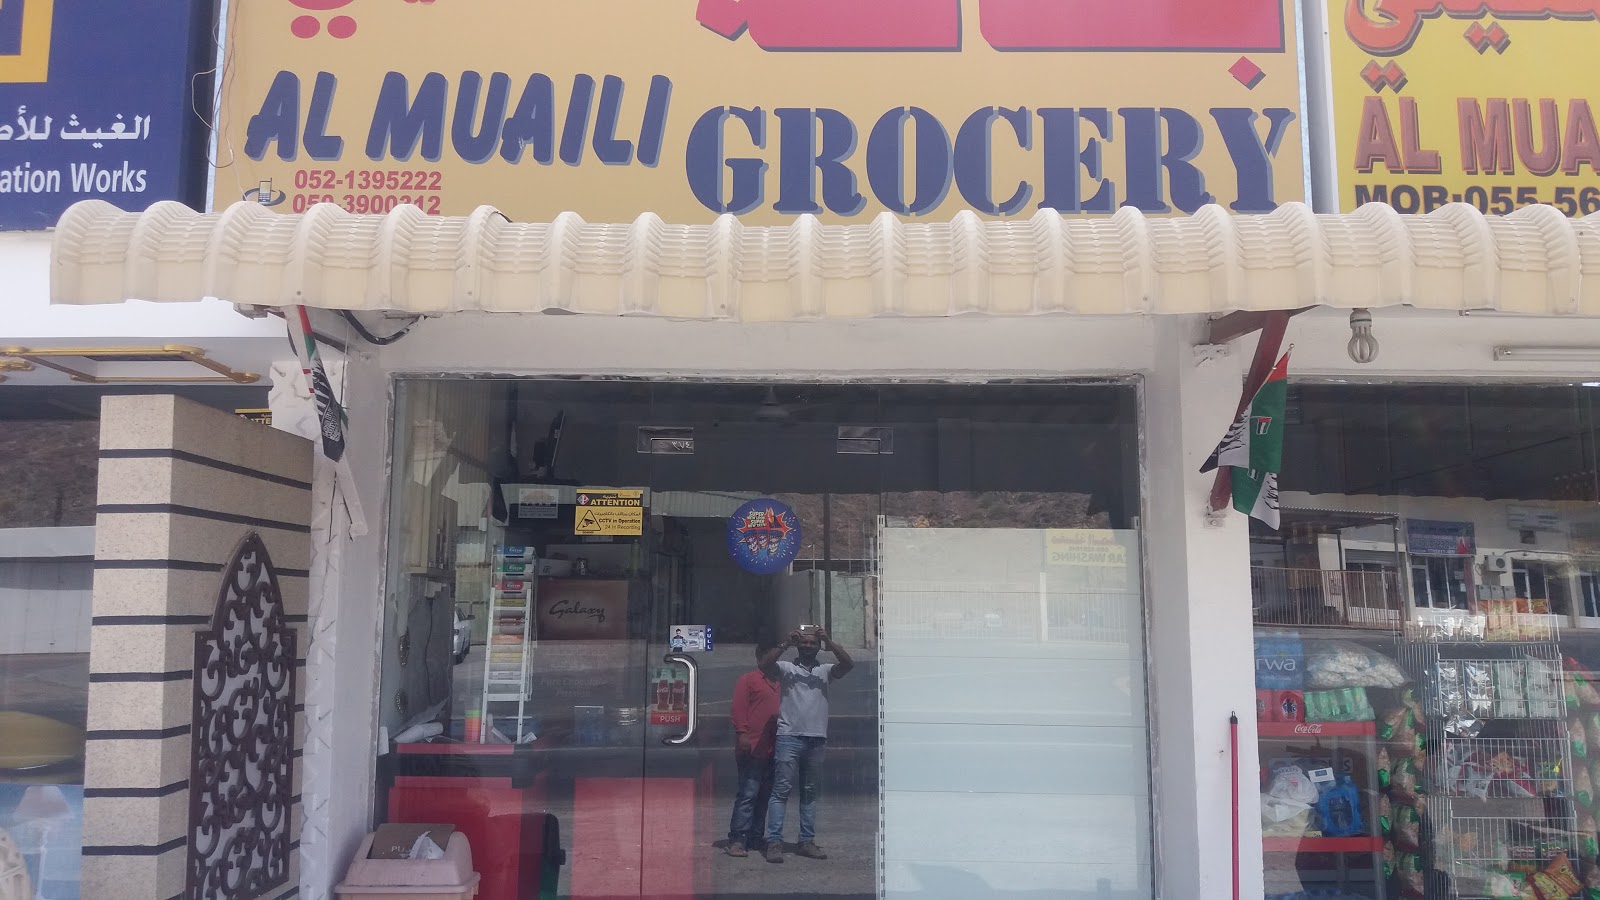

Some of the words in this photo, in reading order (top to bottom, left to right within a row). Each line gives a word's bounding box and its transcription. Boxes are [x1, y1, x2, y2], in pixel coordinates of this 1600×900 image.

[60, 113, 151, 149] الغيث
[244, 70, 344, 162] AL
[365, 70, 673, 168] MUAILI
[1354, 96, 1442, 175] AL
[1457, 97, 1600, 177] MUA
[70, 160, 147, 193] Works
[685, 105, 1297, 216] GROCERY
[294, 169, 442, 191] 052-1395222
[549, 600, 606, 623] Galaxy
[660, 715, 681, 723] PUSH
